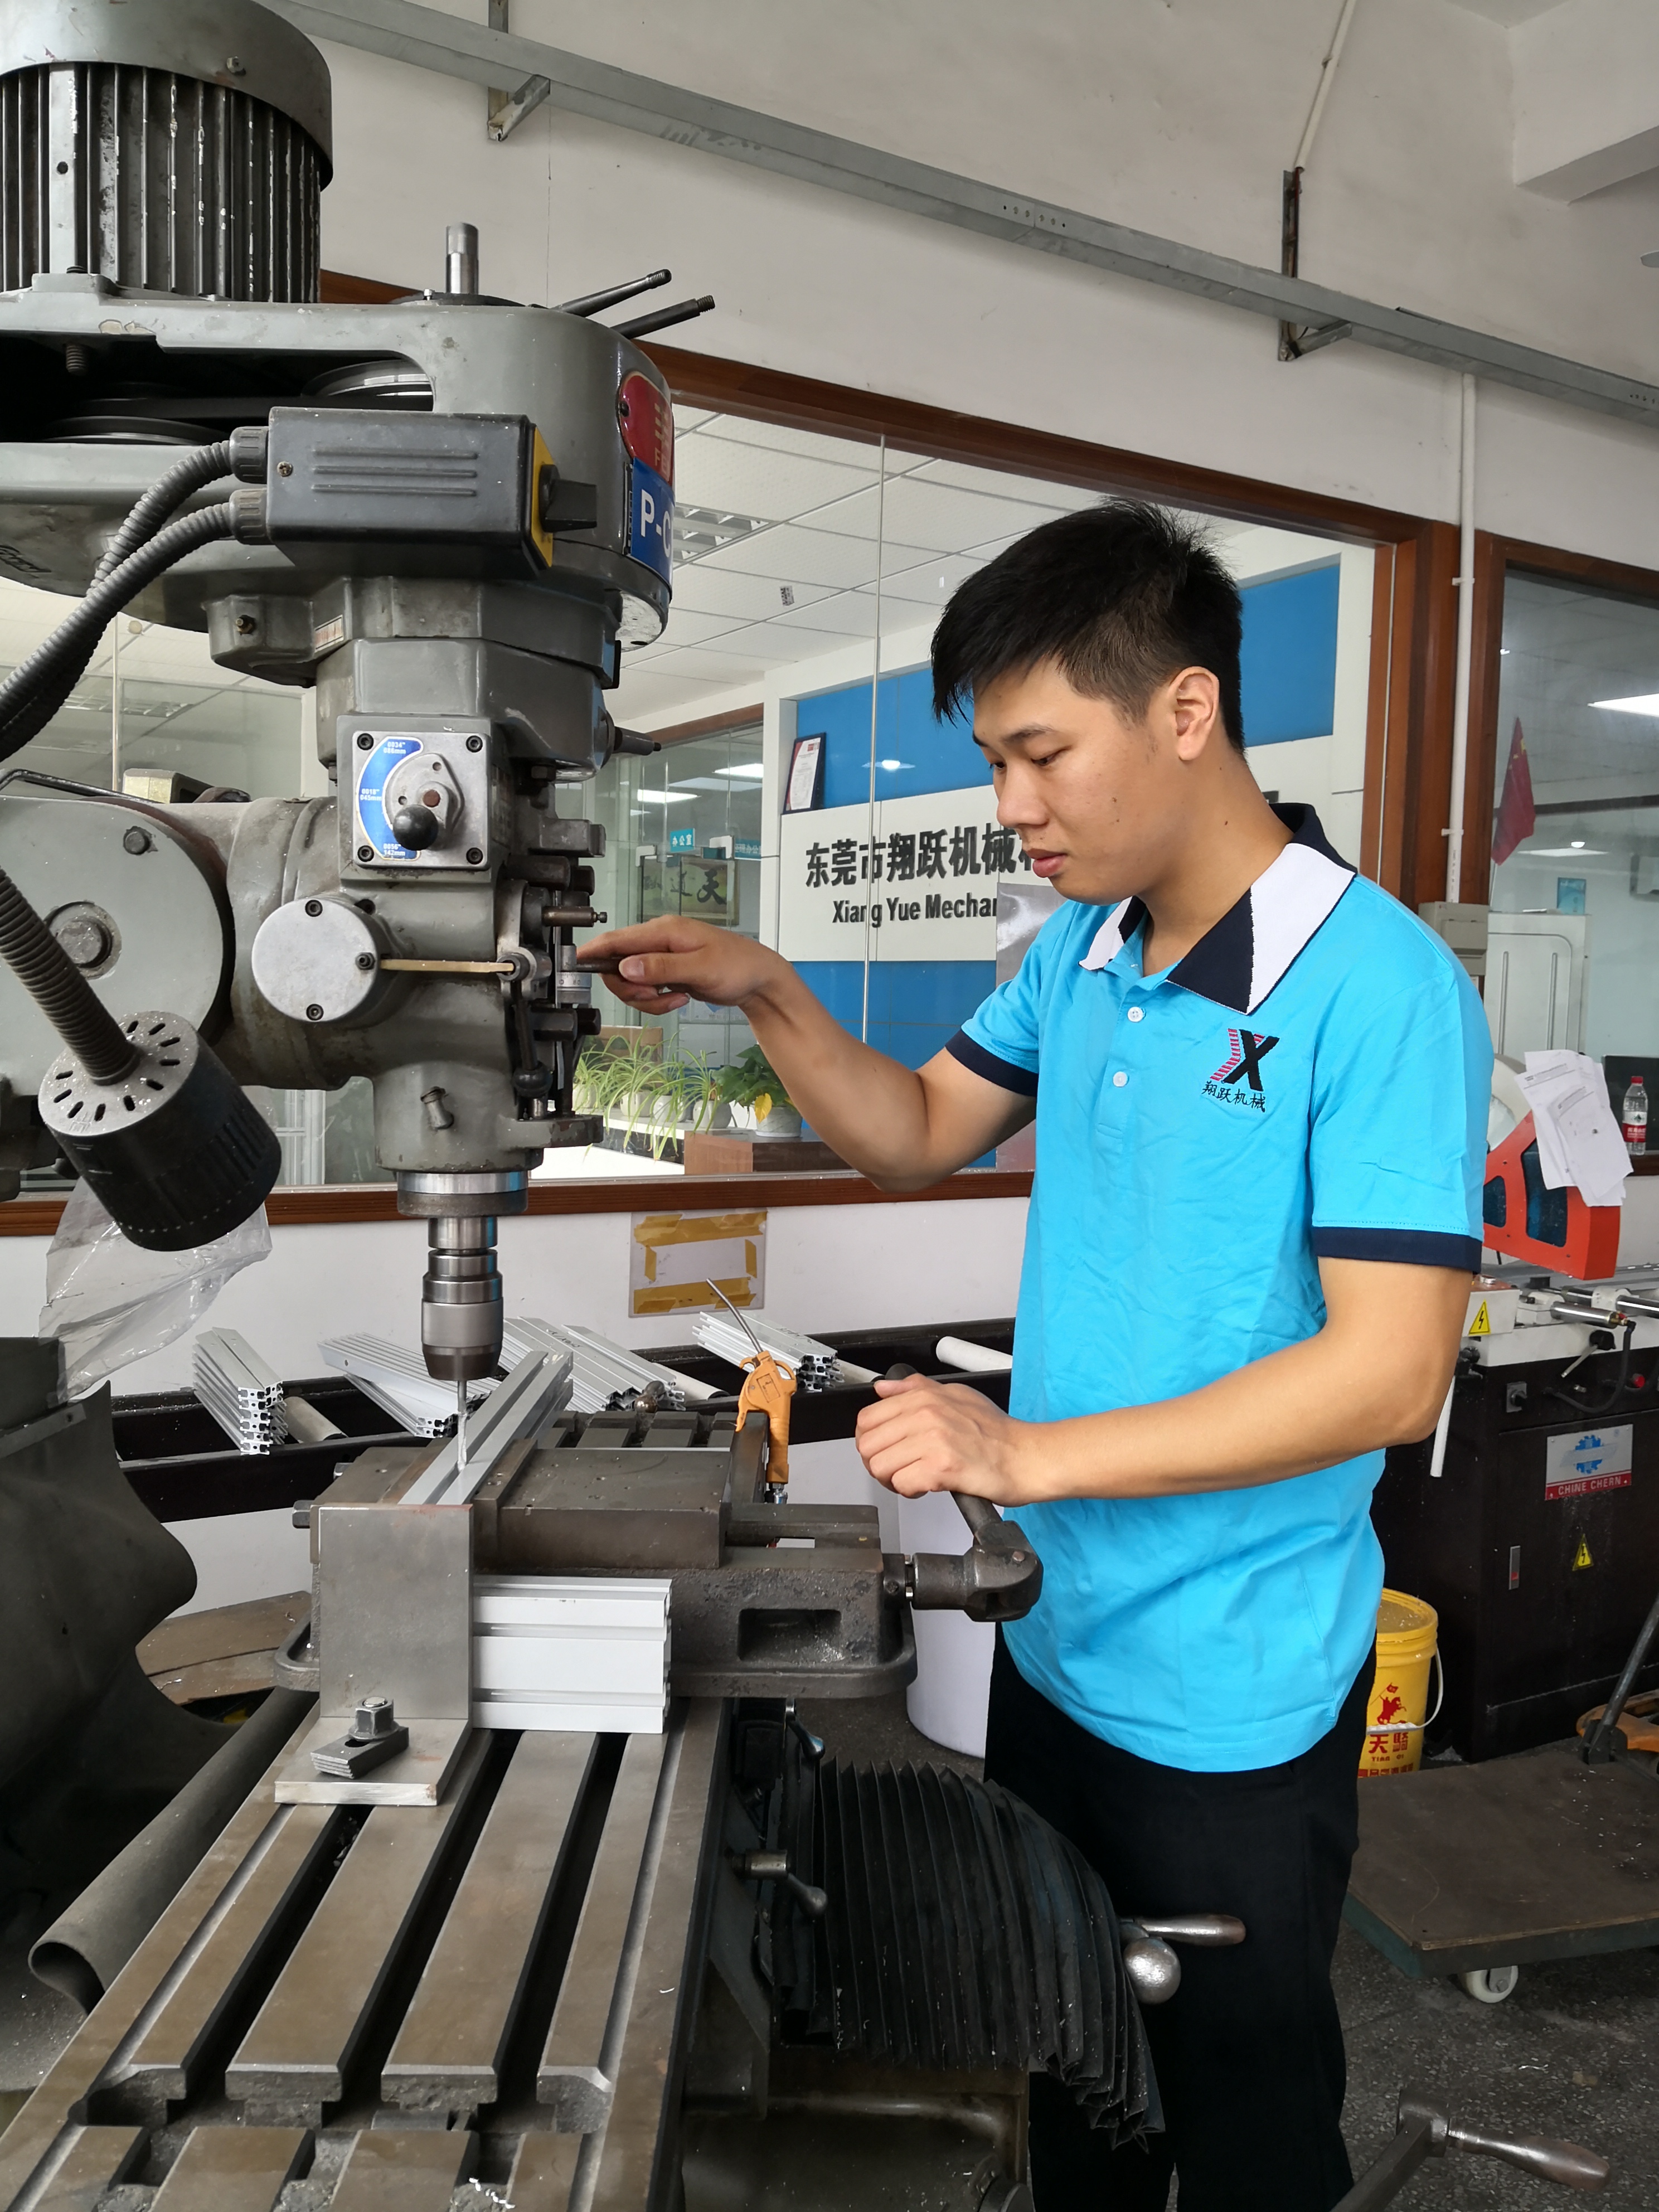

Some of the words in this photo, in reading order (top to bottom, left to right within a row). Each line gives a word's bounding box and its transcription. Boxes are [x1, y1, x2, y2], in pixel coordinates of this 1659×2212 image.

[886, 897, 921, 921] Yue
[1201, 1080, 1265, 1113] 翔跃机械
[1558, 1482, 1587, 1496] CHINE
[1590, 1476, 1622, 1490] CHERN
